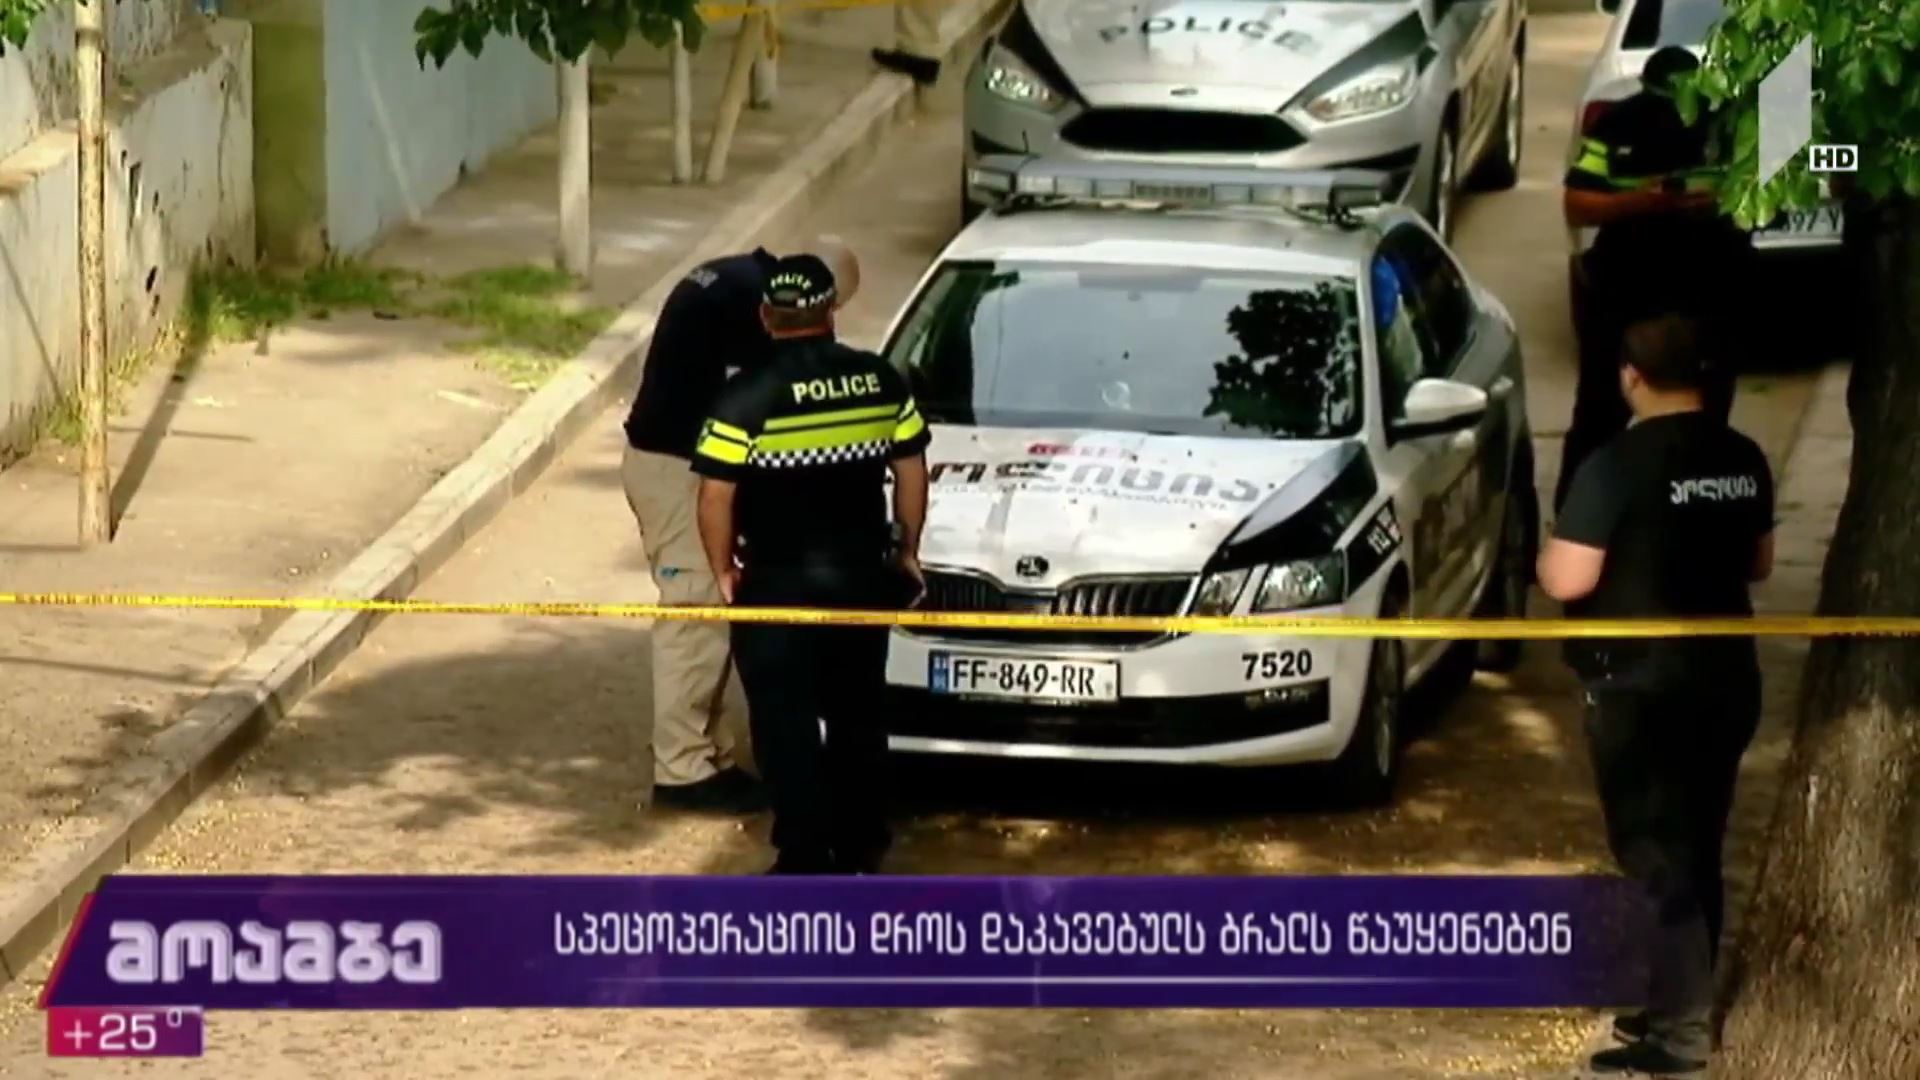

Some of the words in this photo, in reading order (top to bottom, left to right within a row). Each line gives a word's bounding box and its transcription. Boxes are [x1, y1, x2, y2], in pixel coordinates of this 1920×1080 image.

[792, 372, 881, 403] POLICE
[954, 659, 1094, 696] FF-849-RR
[1242, 648, 1312, 681] 7520
